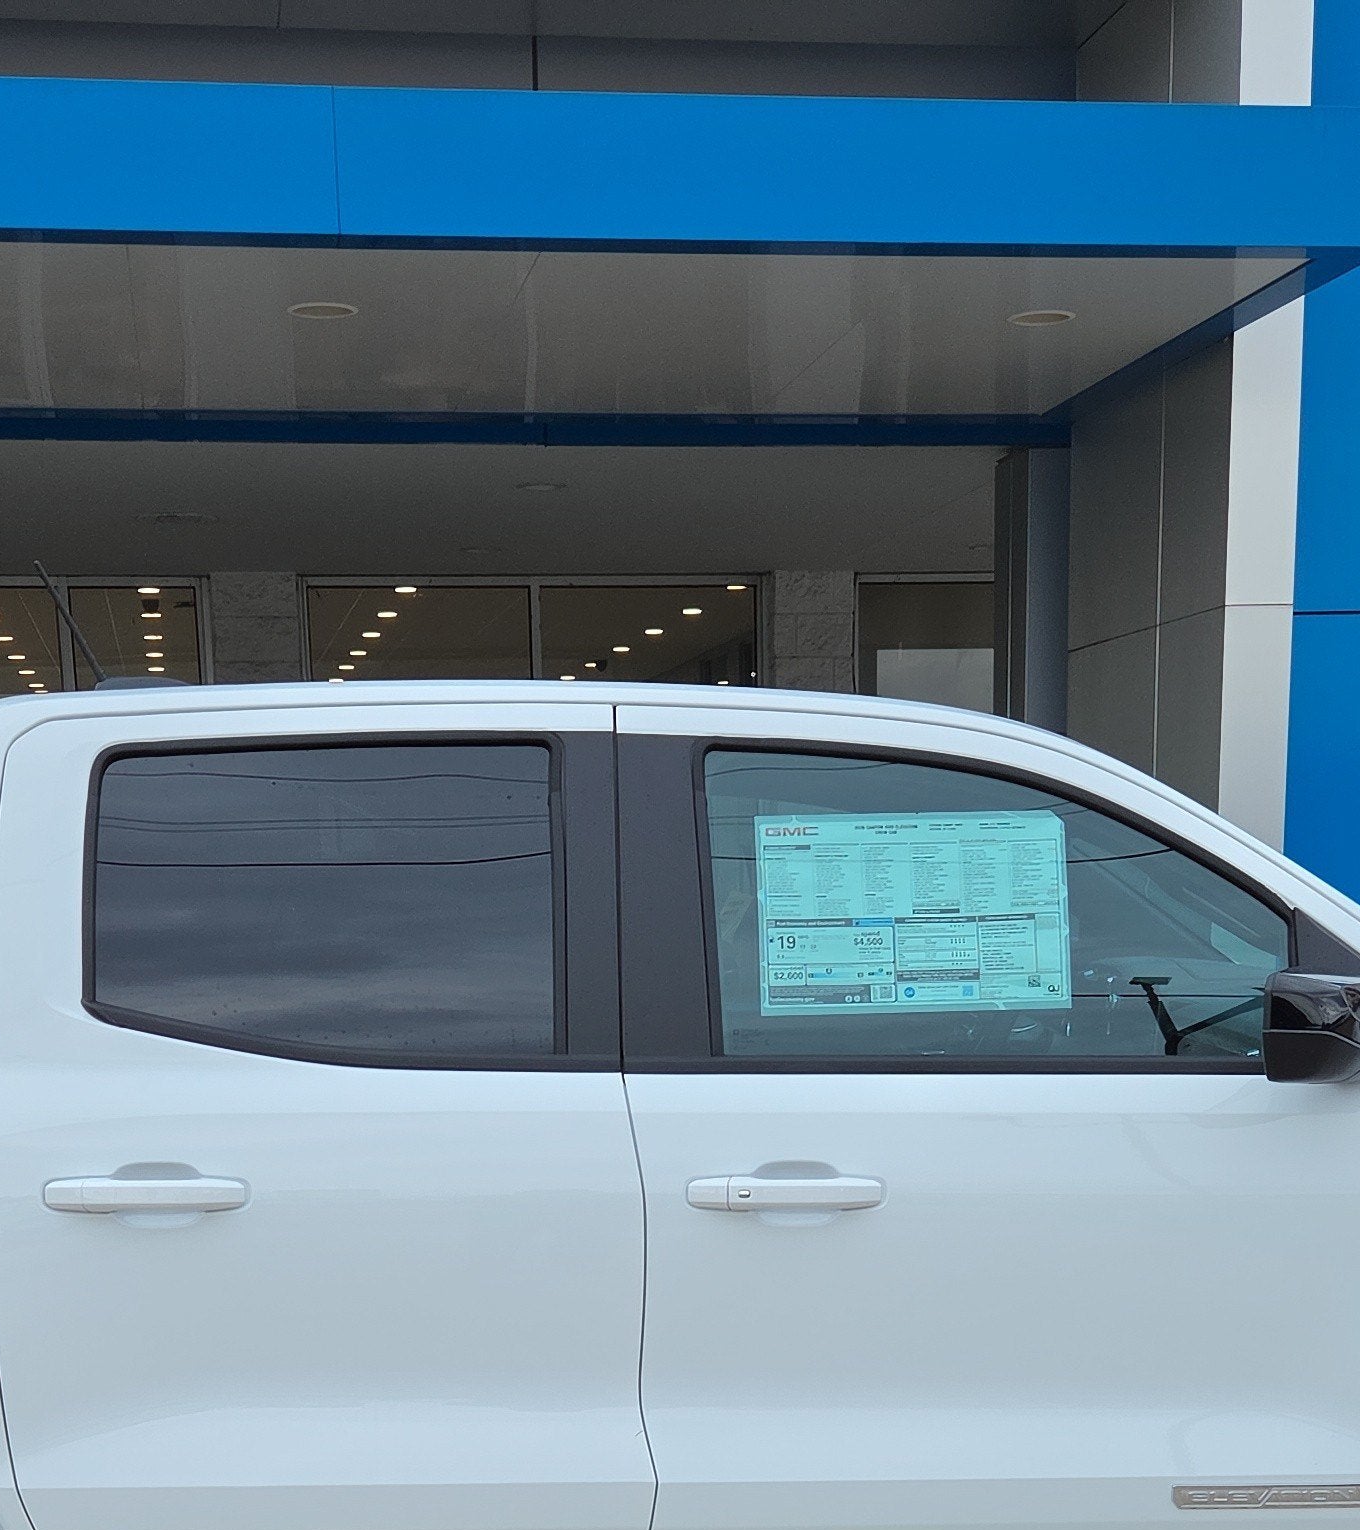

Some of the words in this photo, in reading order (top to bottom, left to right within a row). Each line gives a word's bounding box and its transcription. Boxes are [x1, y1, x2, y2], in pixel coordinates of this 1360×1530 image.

[765, 826, 819, 837] GMC
[777, 935, 796, 950] 19
[853, 937, 884, 947] $4,500
